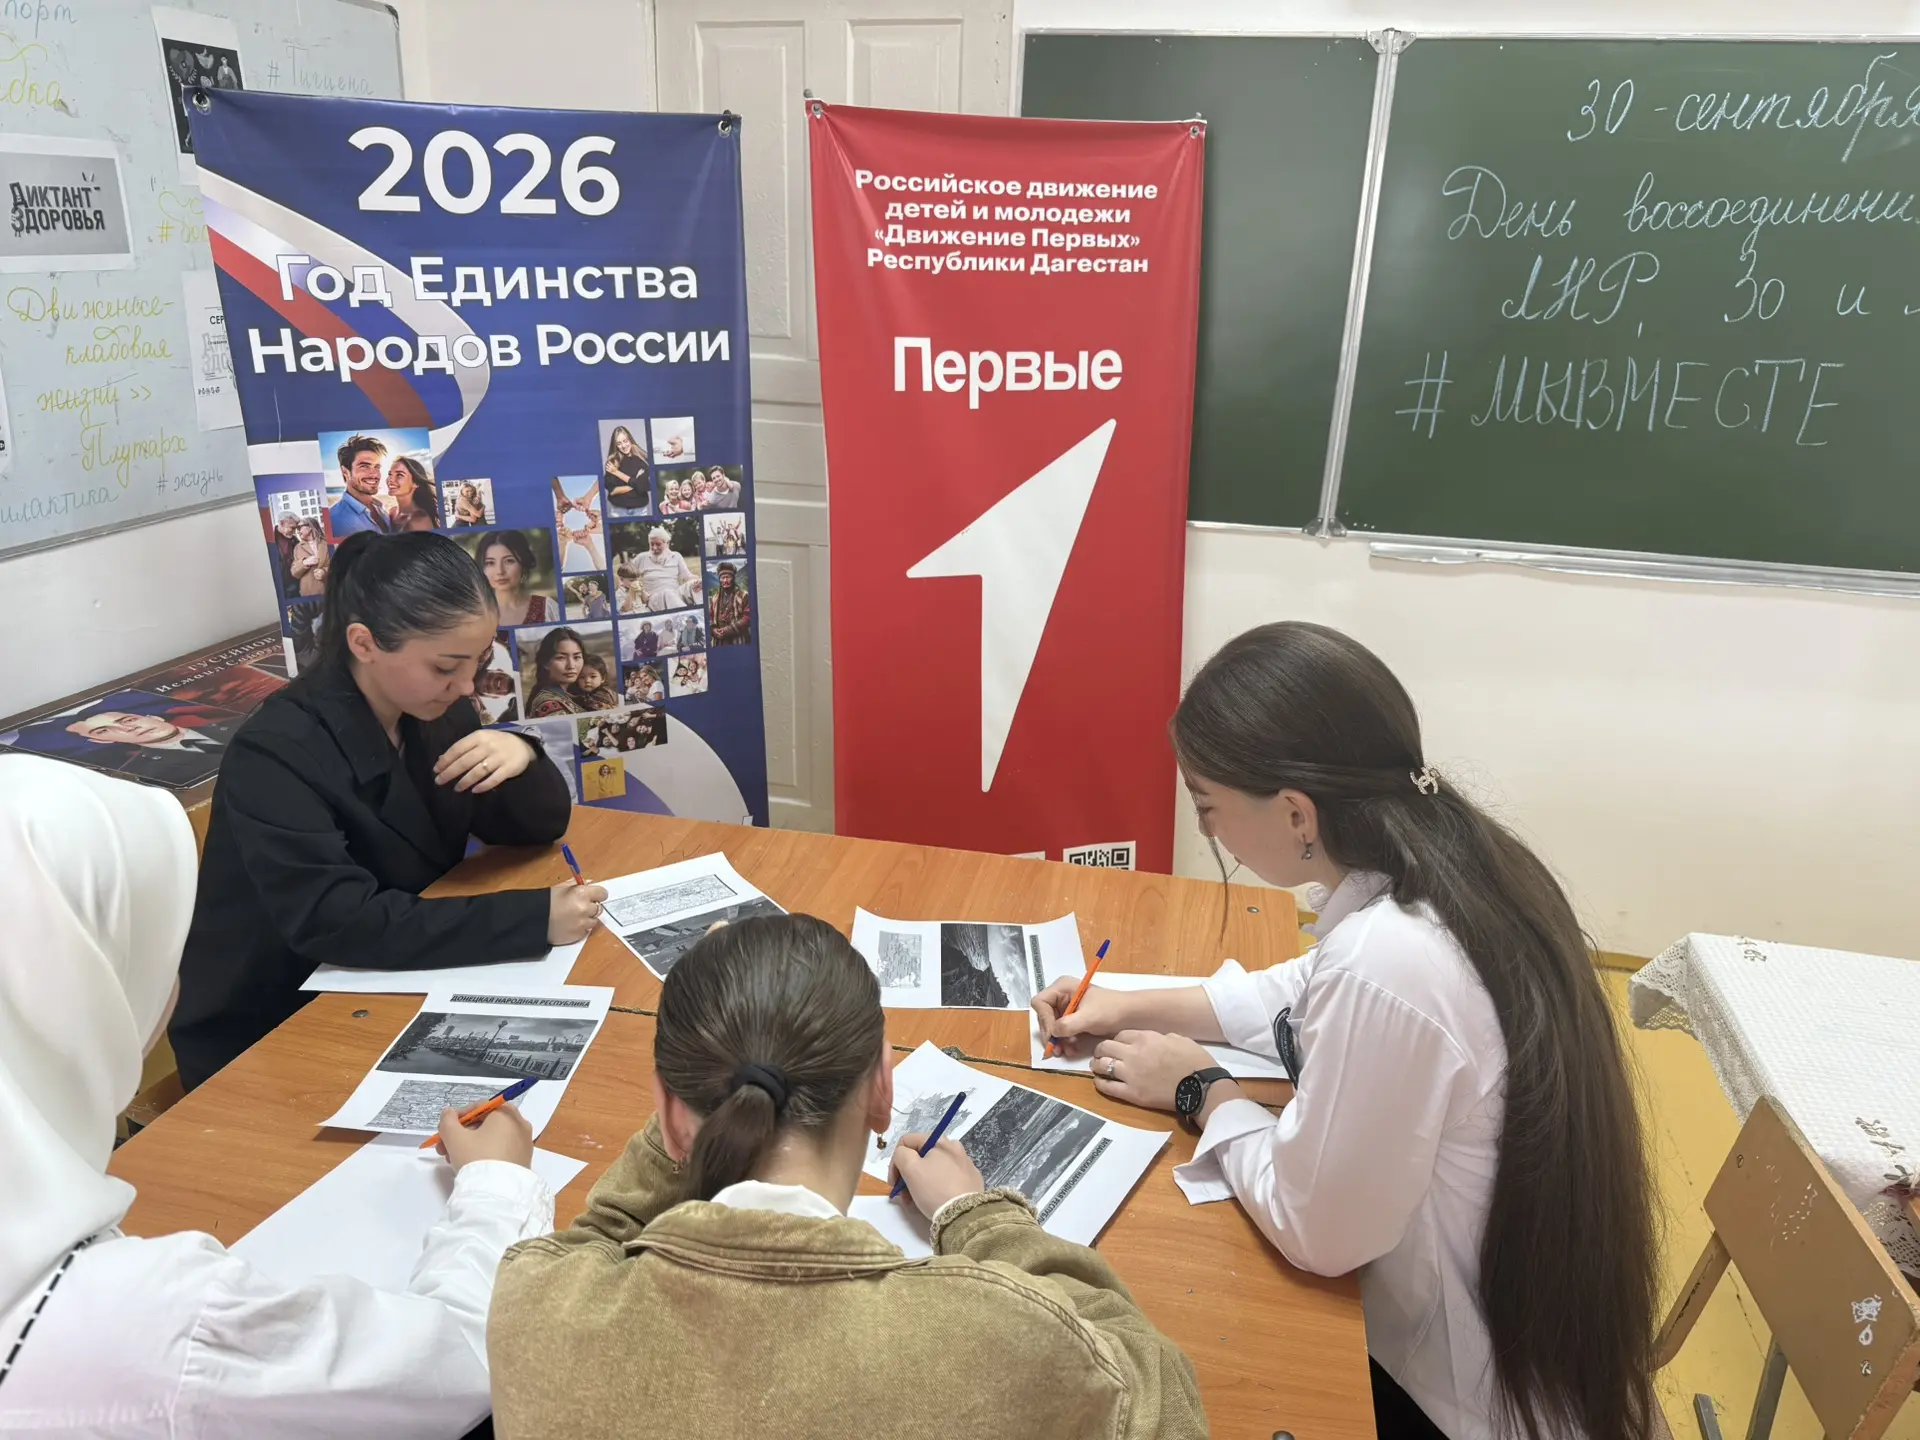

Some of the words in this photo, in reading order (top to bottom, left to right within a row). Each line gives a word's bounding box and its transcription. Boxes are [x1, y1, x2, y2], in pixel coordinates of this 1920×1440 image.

[1567, 79, 1634, 142] 30
[348, 127, 621, 216] 2026
[855, 169, 1022, 196] Российское
[1026, 181, 1158, 199] движение
[9, 181, 93, 208] ДИКТАНТ
[10, 207, 106, 236] ЗДОРОВЬЯ
[885, 199, 967, 220] детей
[972, 206, 989, 220] и
[994, 206, 1131, 224] молодежи
[1442, 165, 1577, 240] День
[1623, 172, 1920, 260] воссоединени
[874, 224, 1026, 248] «Движение
[1031, 228, 1140, 251] Первых»
[867, 248, 1026, 275] Республики
[1030, 253, 1149, 276] Дагестан
[275, 254, 393, 307] Год
[410, 256, 699, 307] Единства
[1725, 249, 1785, 323] 30
[1837, 284, 1871, 316] и
[247, 328, 521, 382] Народов
[537, 323, 732, 367] России
[894, 336, 1123, 410] Первые
[80, 422, 189, 488] Плутарх
[188, 636, 276, 671] ГУСЕЙНОВ
[155, 665, 225, 693] Исмаил
[450, 994, 495, 1004] ДОНЕЦКАЯ
[495, 997, 539, 1005] НАРОДНАЯ
[540, 999, 590, 1008] РЕСПУБЛИКА
[1059, 1171, 1082, 1199] НАРОДНАЯ
